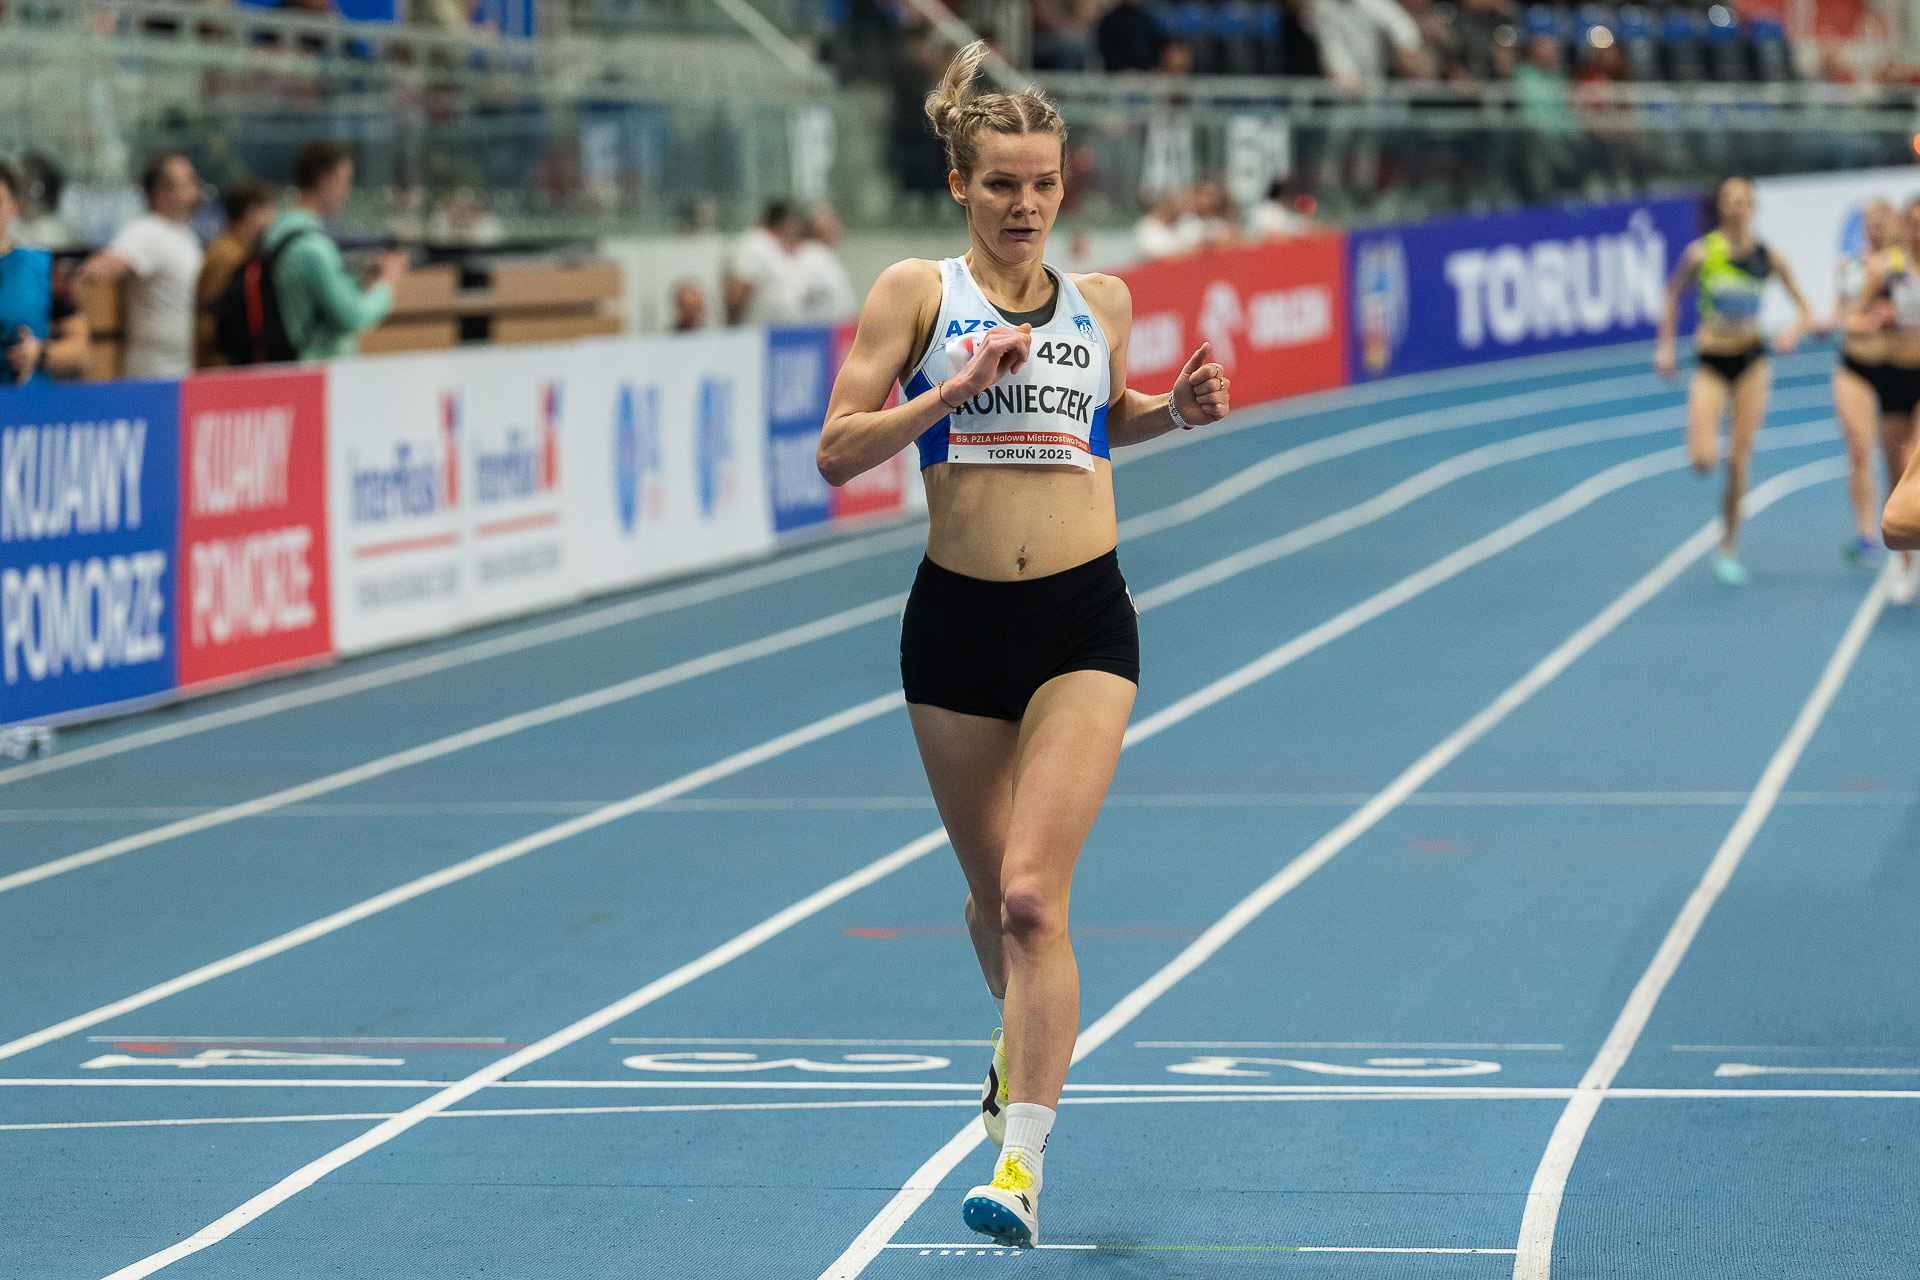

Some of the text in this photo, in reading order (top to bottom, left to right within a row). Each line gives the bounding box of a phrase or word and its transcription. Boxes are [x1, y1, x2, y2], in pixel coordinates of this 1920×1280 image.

[1444, 208, 1665, 348] TORUŃ
[946, 319, 997, 338] AZS
[1037, 341, 1090, 369] 420
[956, 434, 970, 443] 69.
[971, 434, 992, 444] PZLA
[993, 434, 1025, 443] Halowe
[1027, 433, 1075, 445] Mistrzostwa
[988, 445, 1072, 460] TORUŃ 2025
